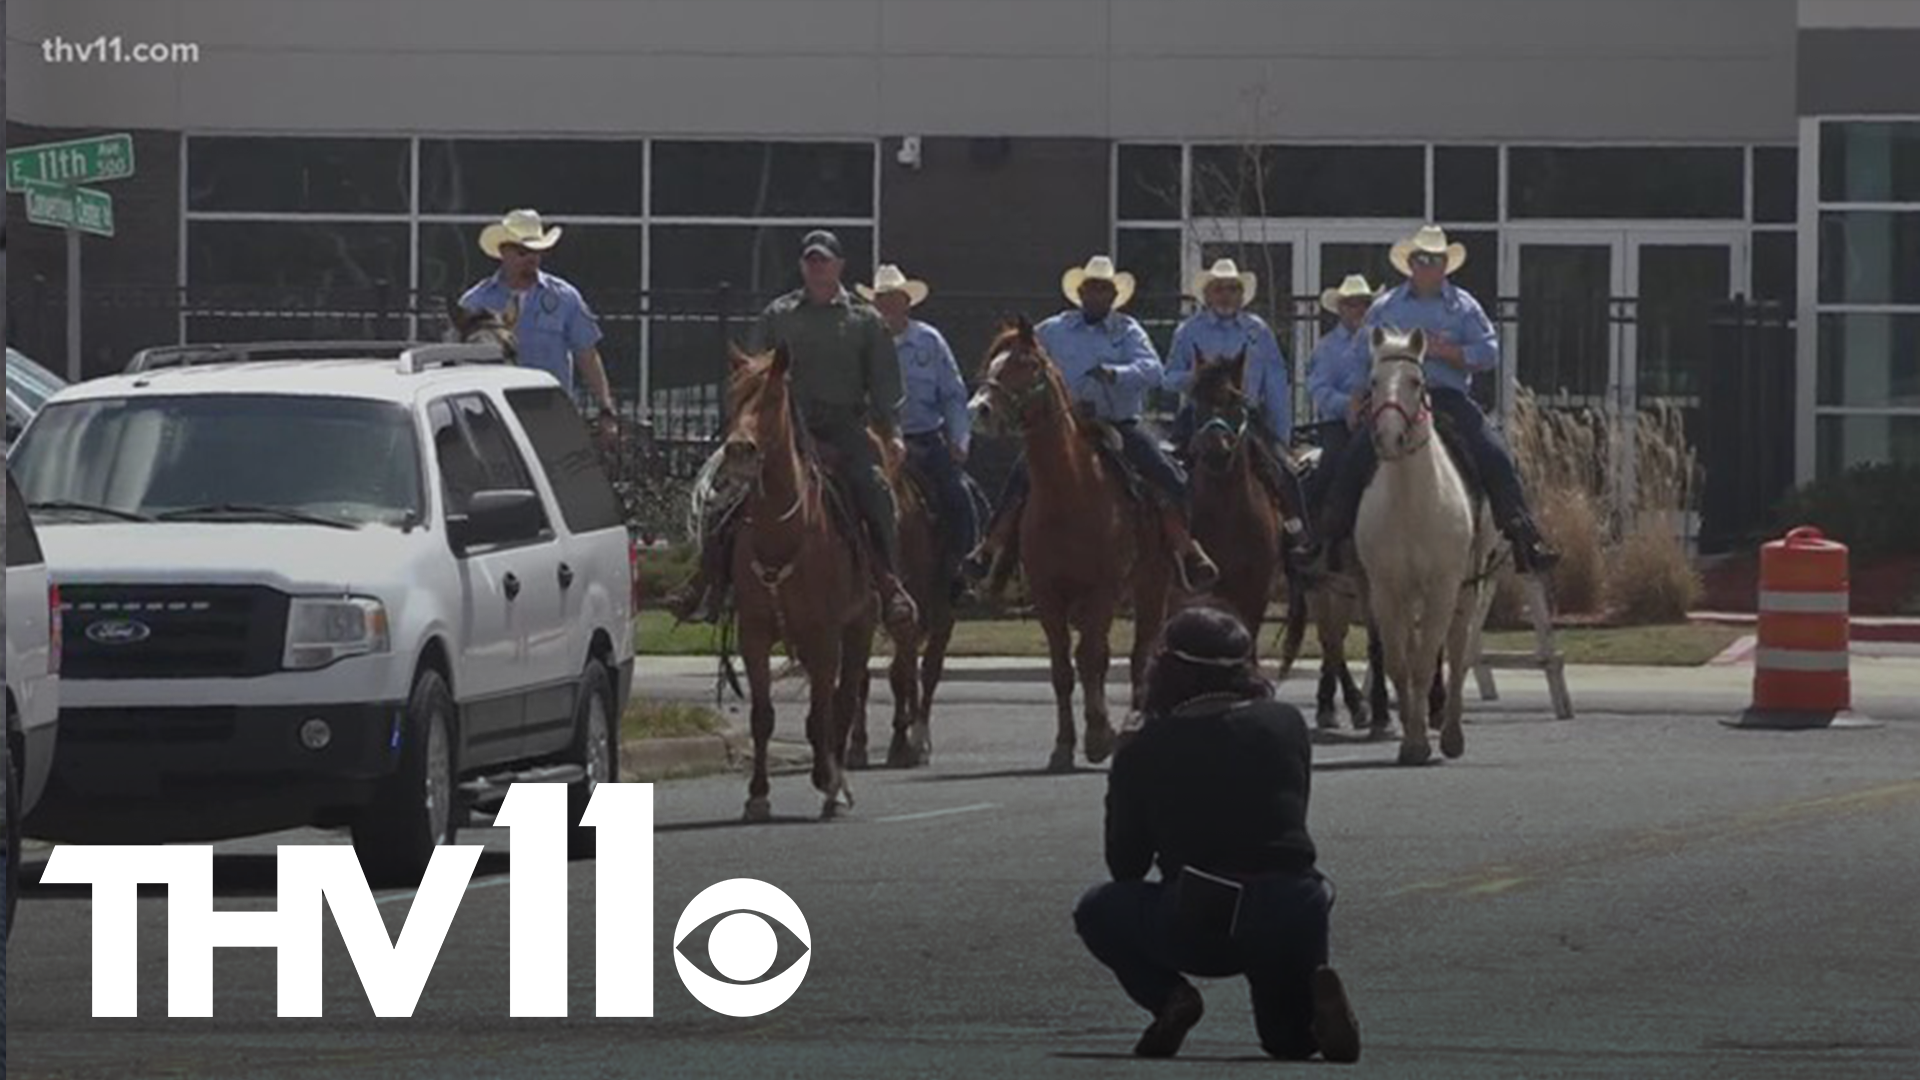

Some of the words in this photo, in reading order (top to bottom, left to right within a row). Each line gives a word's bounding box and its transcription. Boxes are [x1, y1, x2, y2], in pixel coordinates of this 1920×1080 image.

[12, 159, 24, 181] E
[38, 149, 87, 182] 11th
[98, 621, 135, 638] Ford
